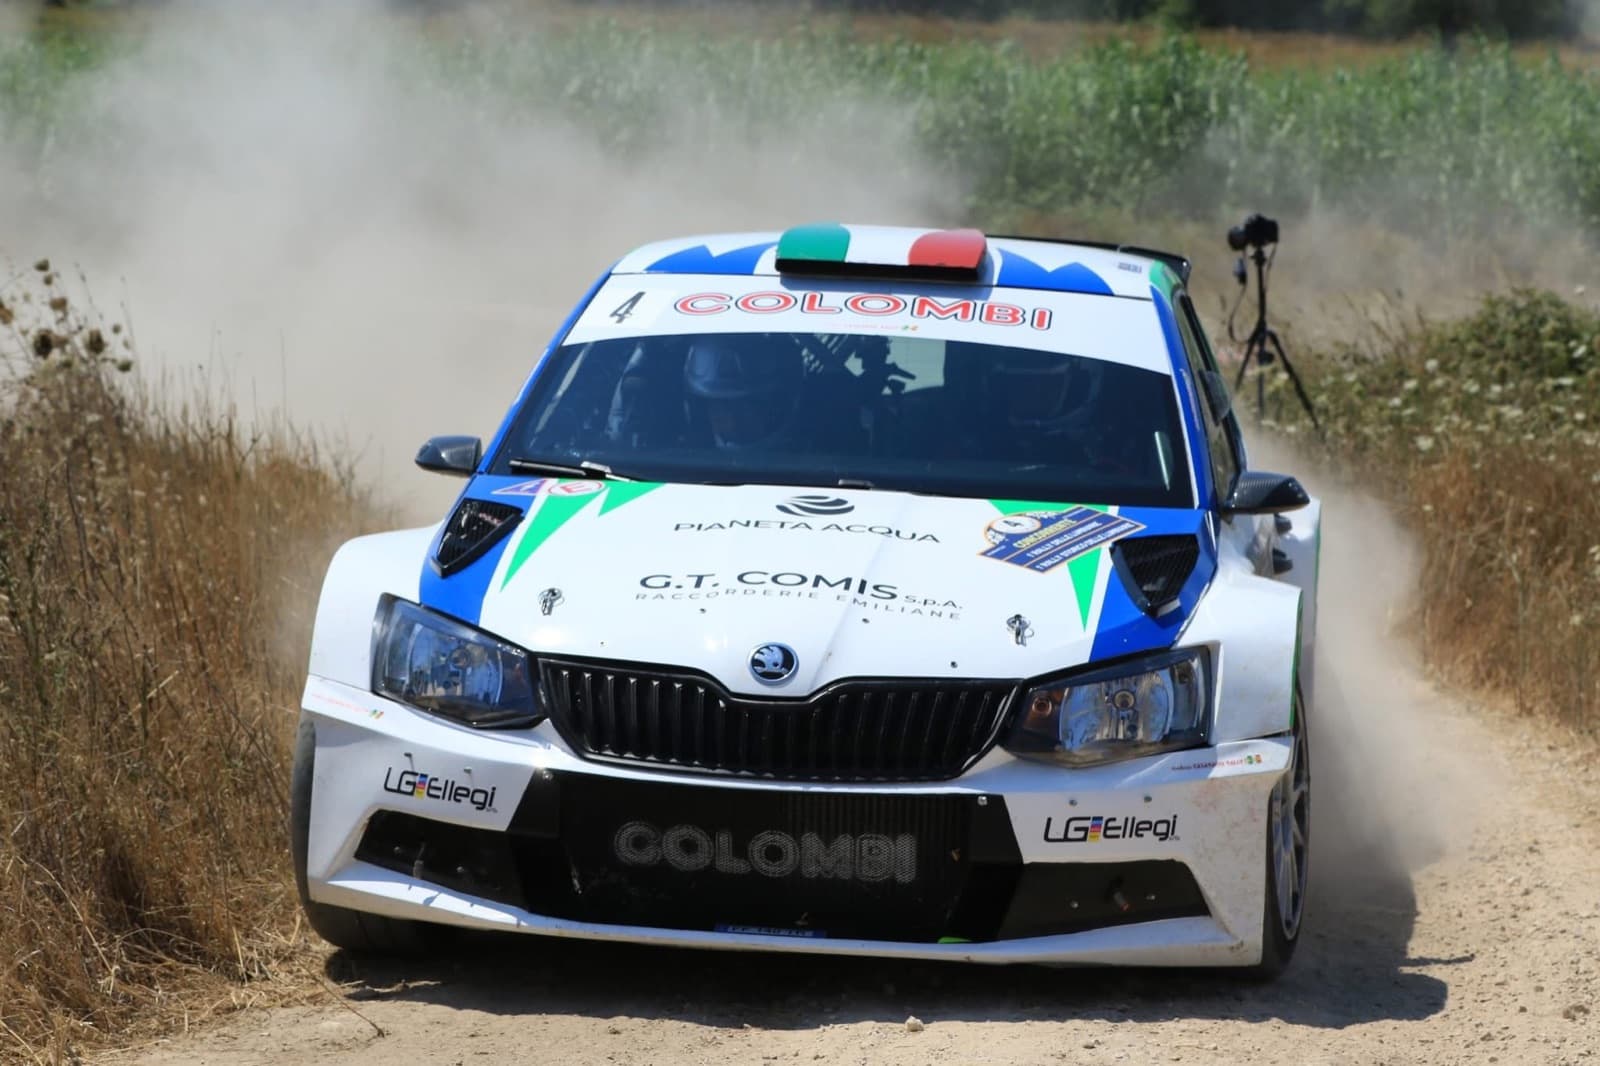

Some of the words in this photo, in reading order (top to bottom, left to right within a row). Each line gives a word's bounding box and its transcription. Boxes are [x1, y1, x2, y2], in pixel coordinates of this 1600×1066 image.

[609, 291, 646, 324] 4
[674, 291, 1052, 330] COLOMBI
[674, 520, 812, 532] PIANETA
[821, 523, 941, 543] ACQUA
[640, 574, 719, 590] G.T.
[737, 571, 898, 600] COMIS
[635, 588, 819, 601] RACCORDERIE
[836, 594, 961, 619] EMILIANE
[614, 820, 917, 884] COLOMBI
